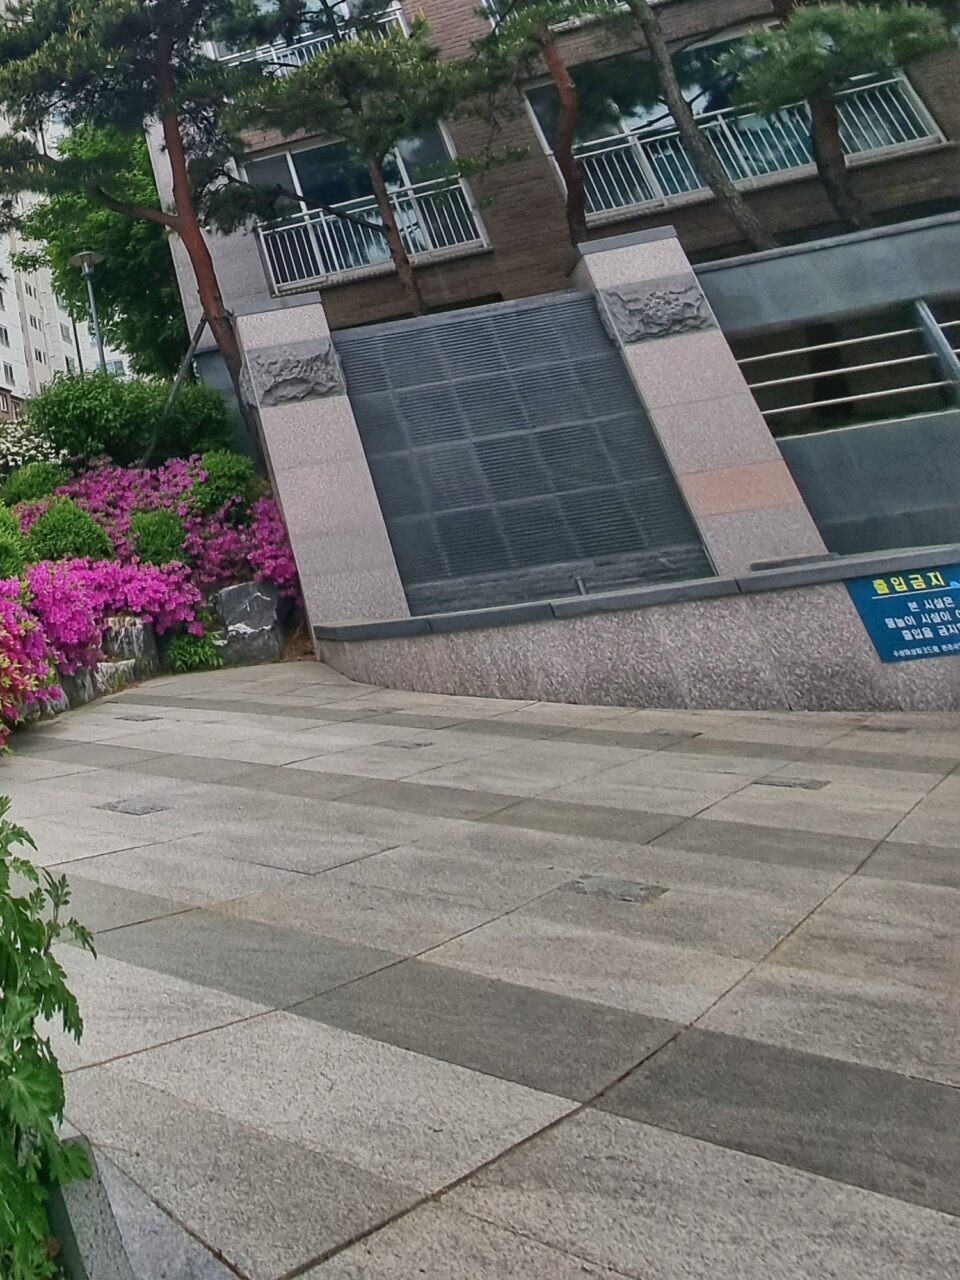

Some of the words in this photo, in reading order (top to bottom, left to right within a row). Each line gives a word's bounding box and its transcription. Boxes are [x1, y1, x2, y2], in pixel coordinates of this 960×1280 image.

[873, 572, 945, 594] 출입금지
[908, 602, 920, 612] 본
[924, 597, 955, 609] 시설은
[885, 616, 916, 629] 물놀이
[921, 611, 952, 624] 시설이
[901, 627, 934, 640] 출입을
